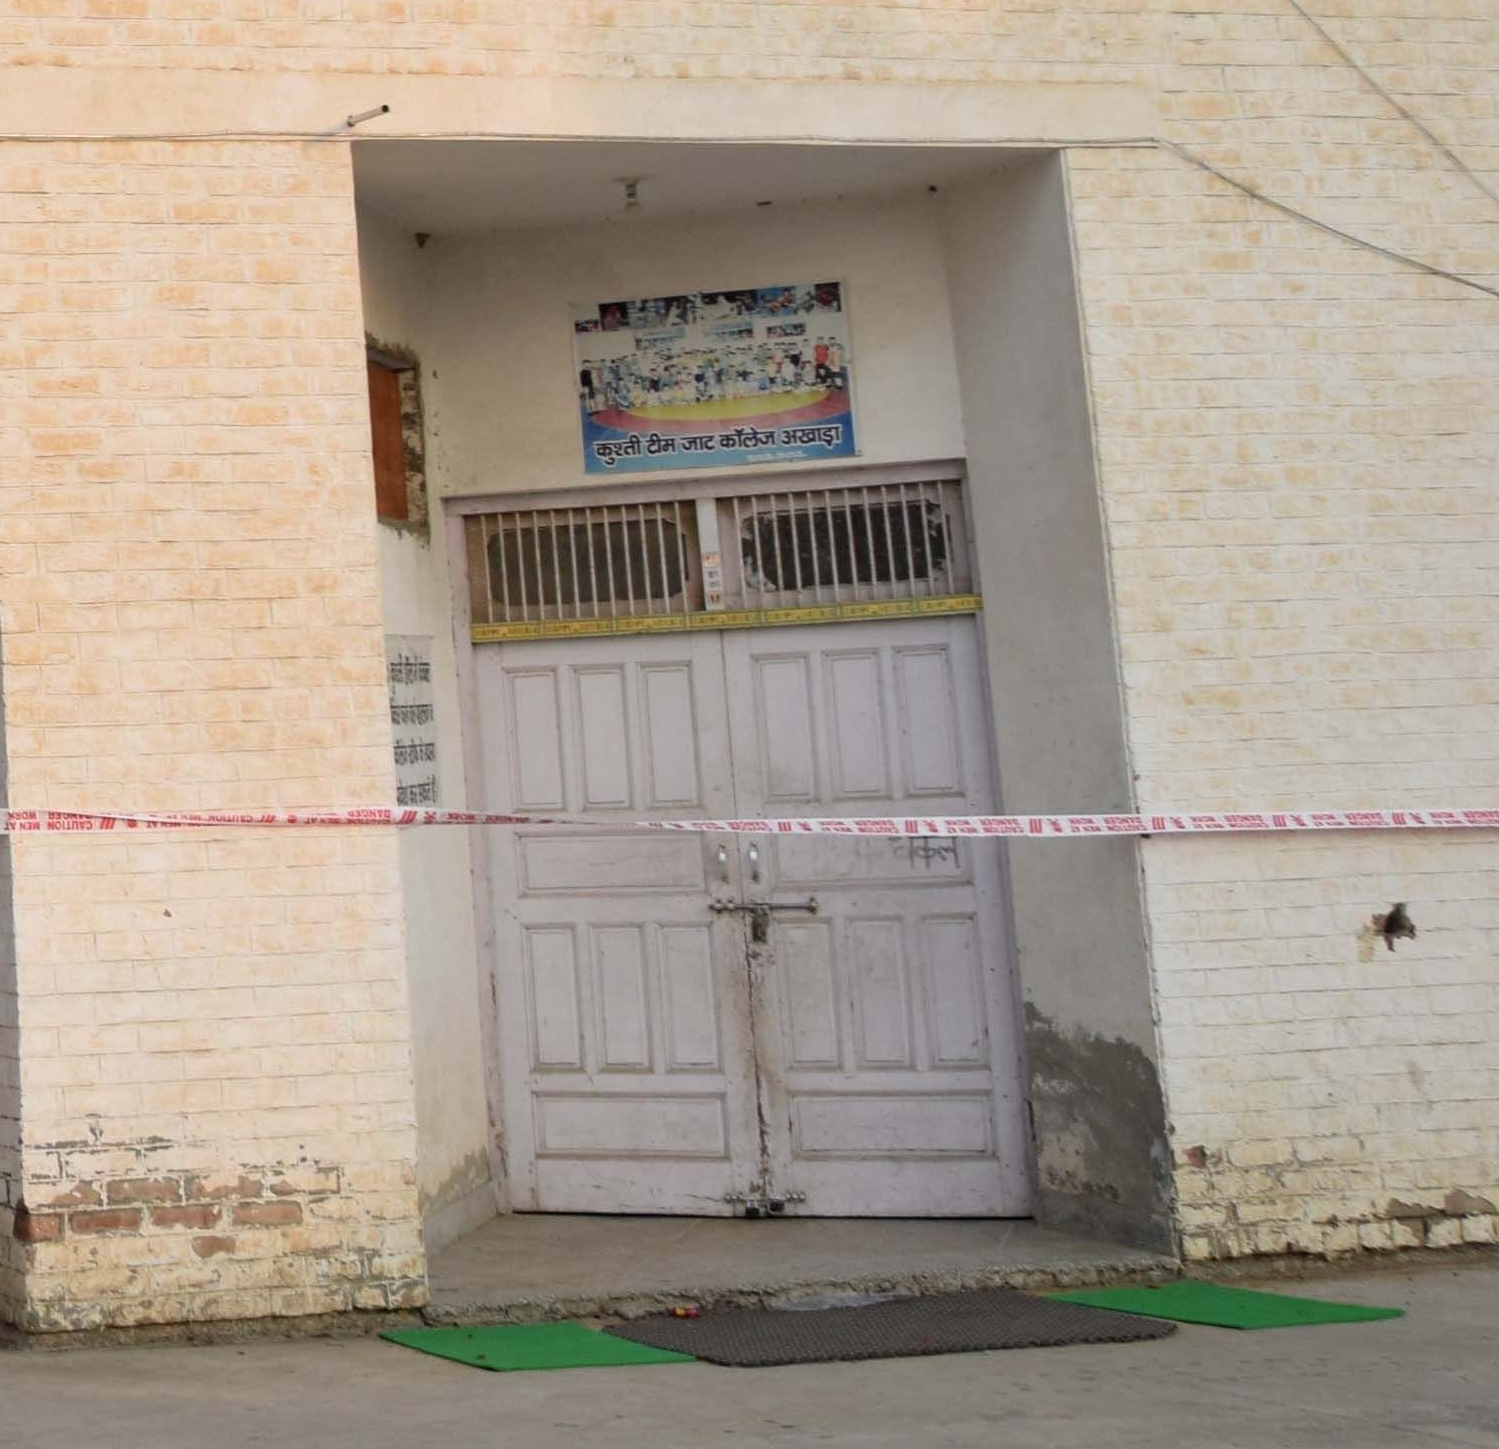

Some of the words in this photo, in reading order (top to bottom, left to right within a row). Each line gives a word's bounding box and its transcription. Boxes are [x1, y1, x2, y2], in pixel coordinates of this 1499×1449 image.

[596, 433, 641, 465] कुश्ती
[647, 433, 675, 455] टीम
[682, 435, 715, 452] जाट
[720, 427, 776, 449] कॉलेज
[8, 811, 36, 819] WORK
[4, 821, 16, 830] AT
[19, 821, 40, 830] MEN
[47, 821, 93, 831] CAUTION
